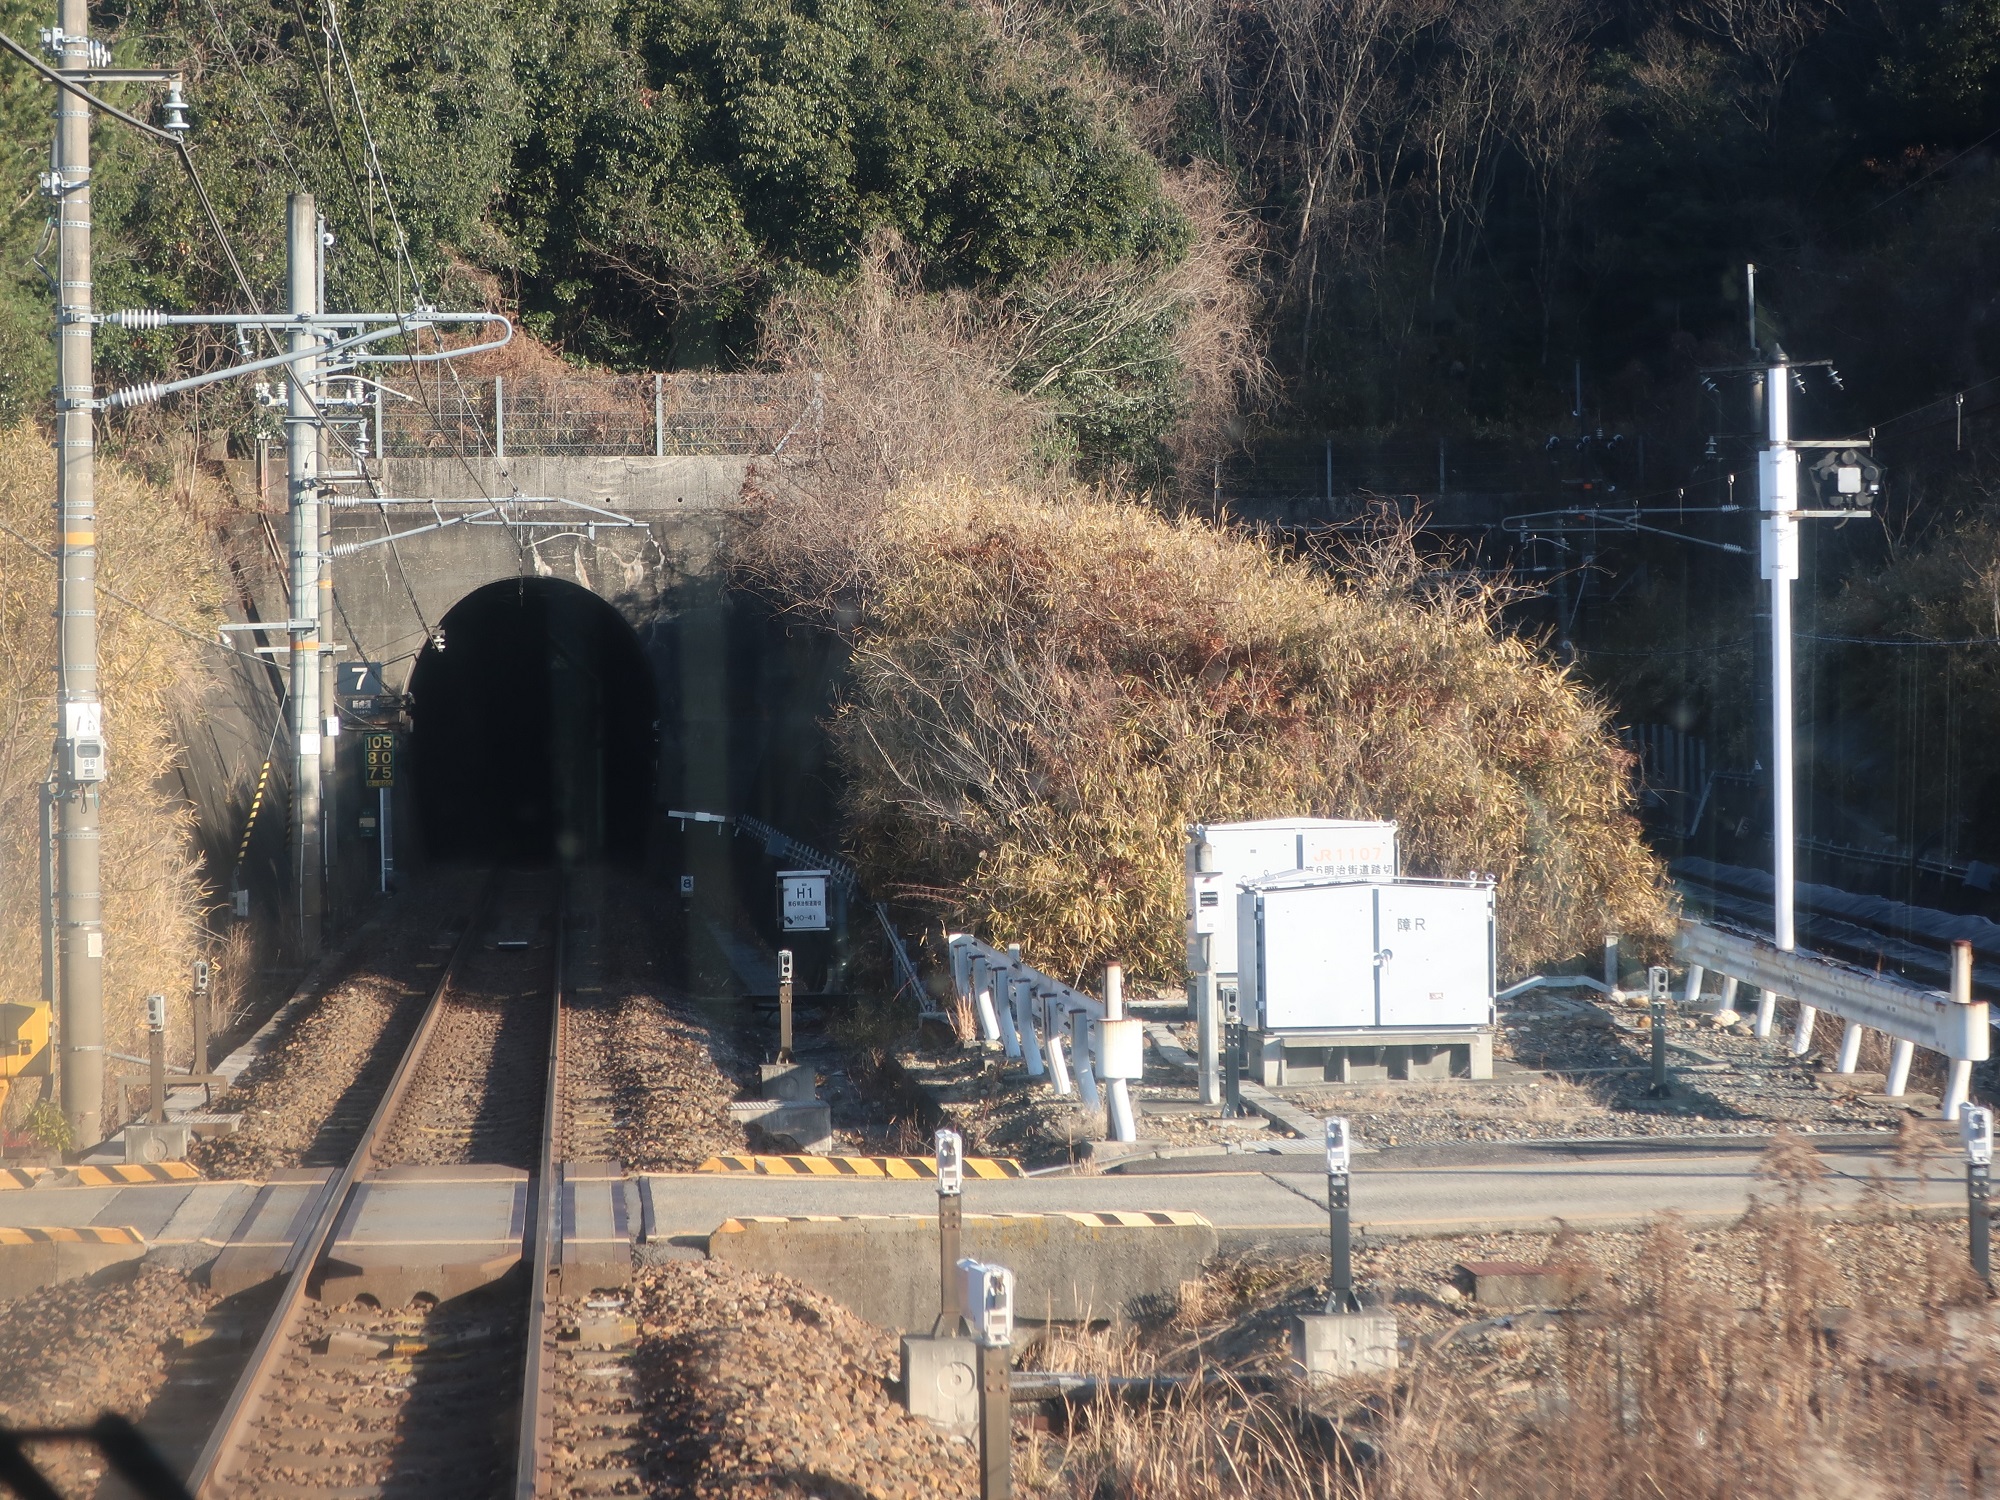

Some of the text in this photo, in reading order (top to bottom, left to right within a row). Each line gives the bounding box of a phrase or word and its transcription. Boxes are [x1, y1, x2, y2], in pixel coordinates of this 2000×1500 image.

[351, 667, 368, 690] 7
[366, 736, 392, 749] 105
[367, 752, 391, 765] 80
[367, 766, 392, 779] 75
[796, 887, 812, 899] H1
